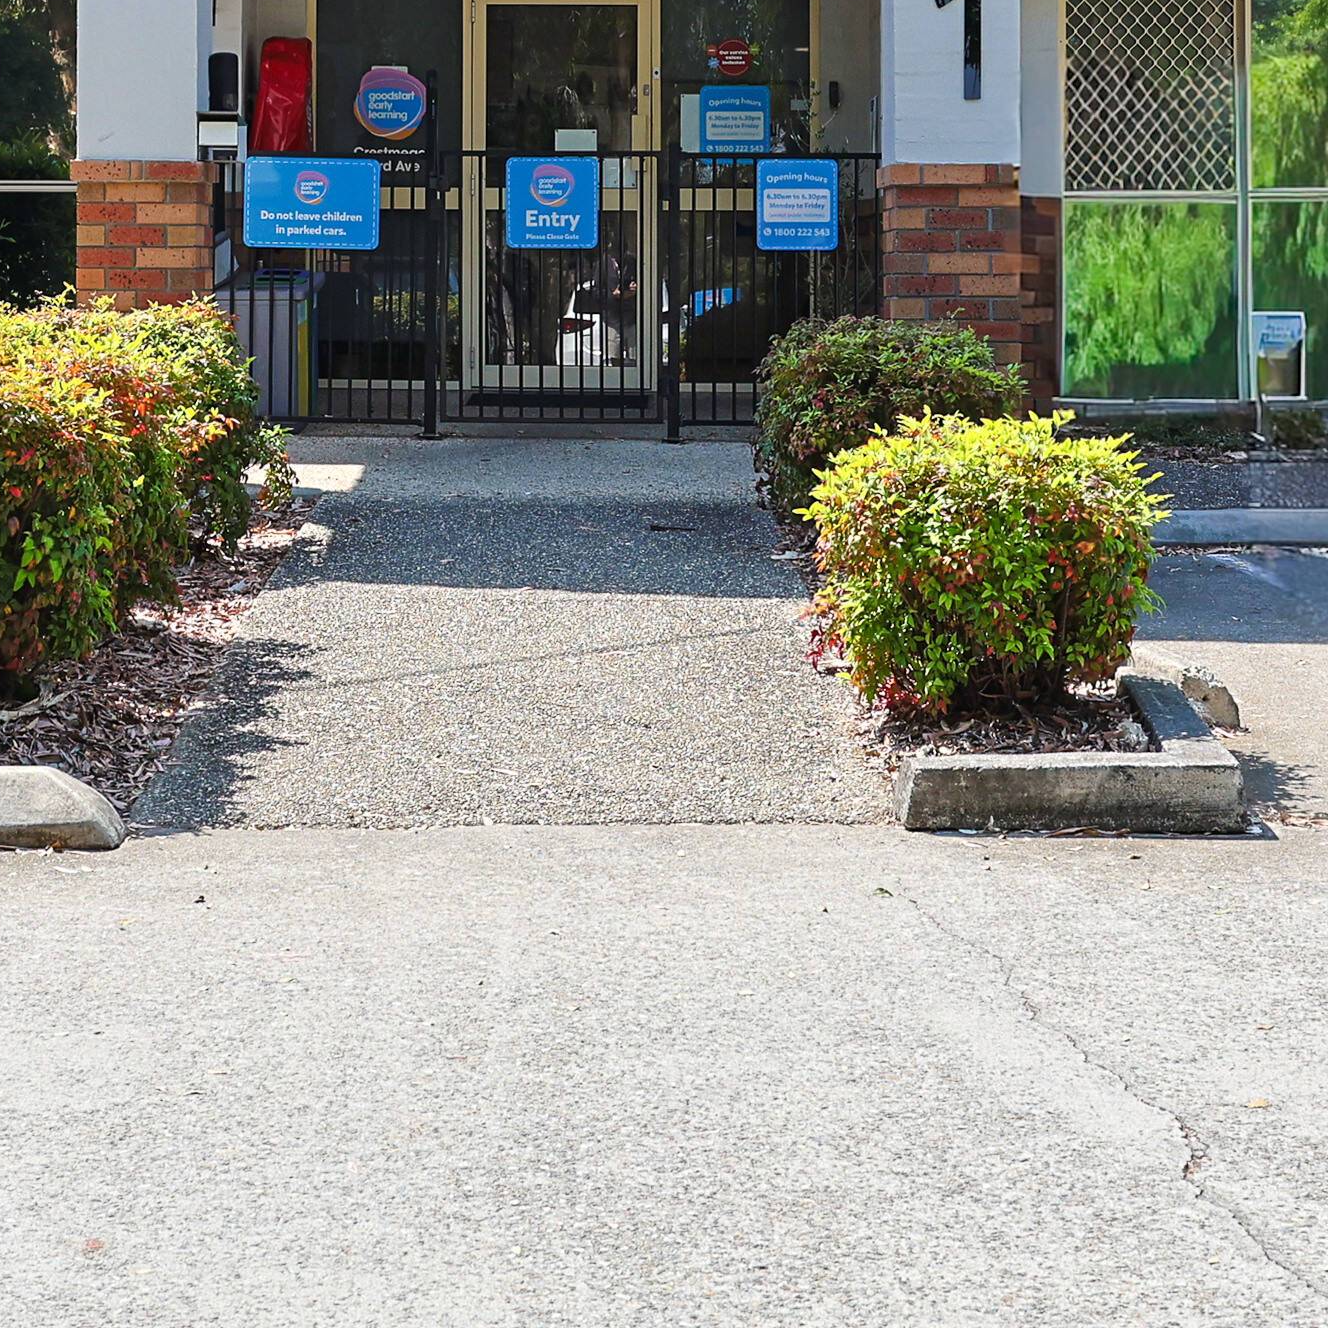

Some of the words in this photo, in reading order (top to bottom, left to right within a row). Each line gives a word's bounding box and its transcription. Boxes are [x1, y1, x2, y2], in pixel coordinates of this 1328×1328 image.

[368, 90, 415, 102] goodstart
[368, 100, 393, 111] early
[708, 98, 740, 107] Opening
[368, 110, 408, 122] learning
[395, 160, 420, 172] Ave
[766, 172, 803, 184] Opening
[803, 172, 828, 183] hours
[769, 202, 795, 210] Monday
[804, 202, 825, 211] Friday
[260, 210, 275, 220] Do
[276, 211, 294, 220] not
[295, 211, 320, 221] leave
[321, 211, 363, 222] children
[525, 210, 581, 232] Entry
[276, 224, 285, 234] in
[287, 225, 322, 236] parked
[323, 226, 347, 235] cars.
[774, 228, 796, 237] 1800
[797, 228, 813, 237] 222
[814, 228, 831, 237] 543
